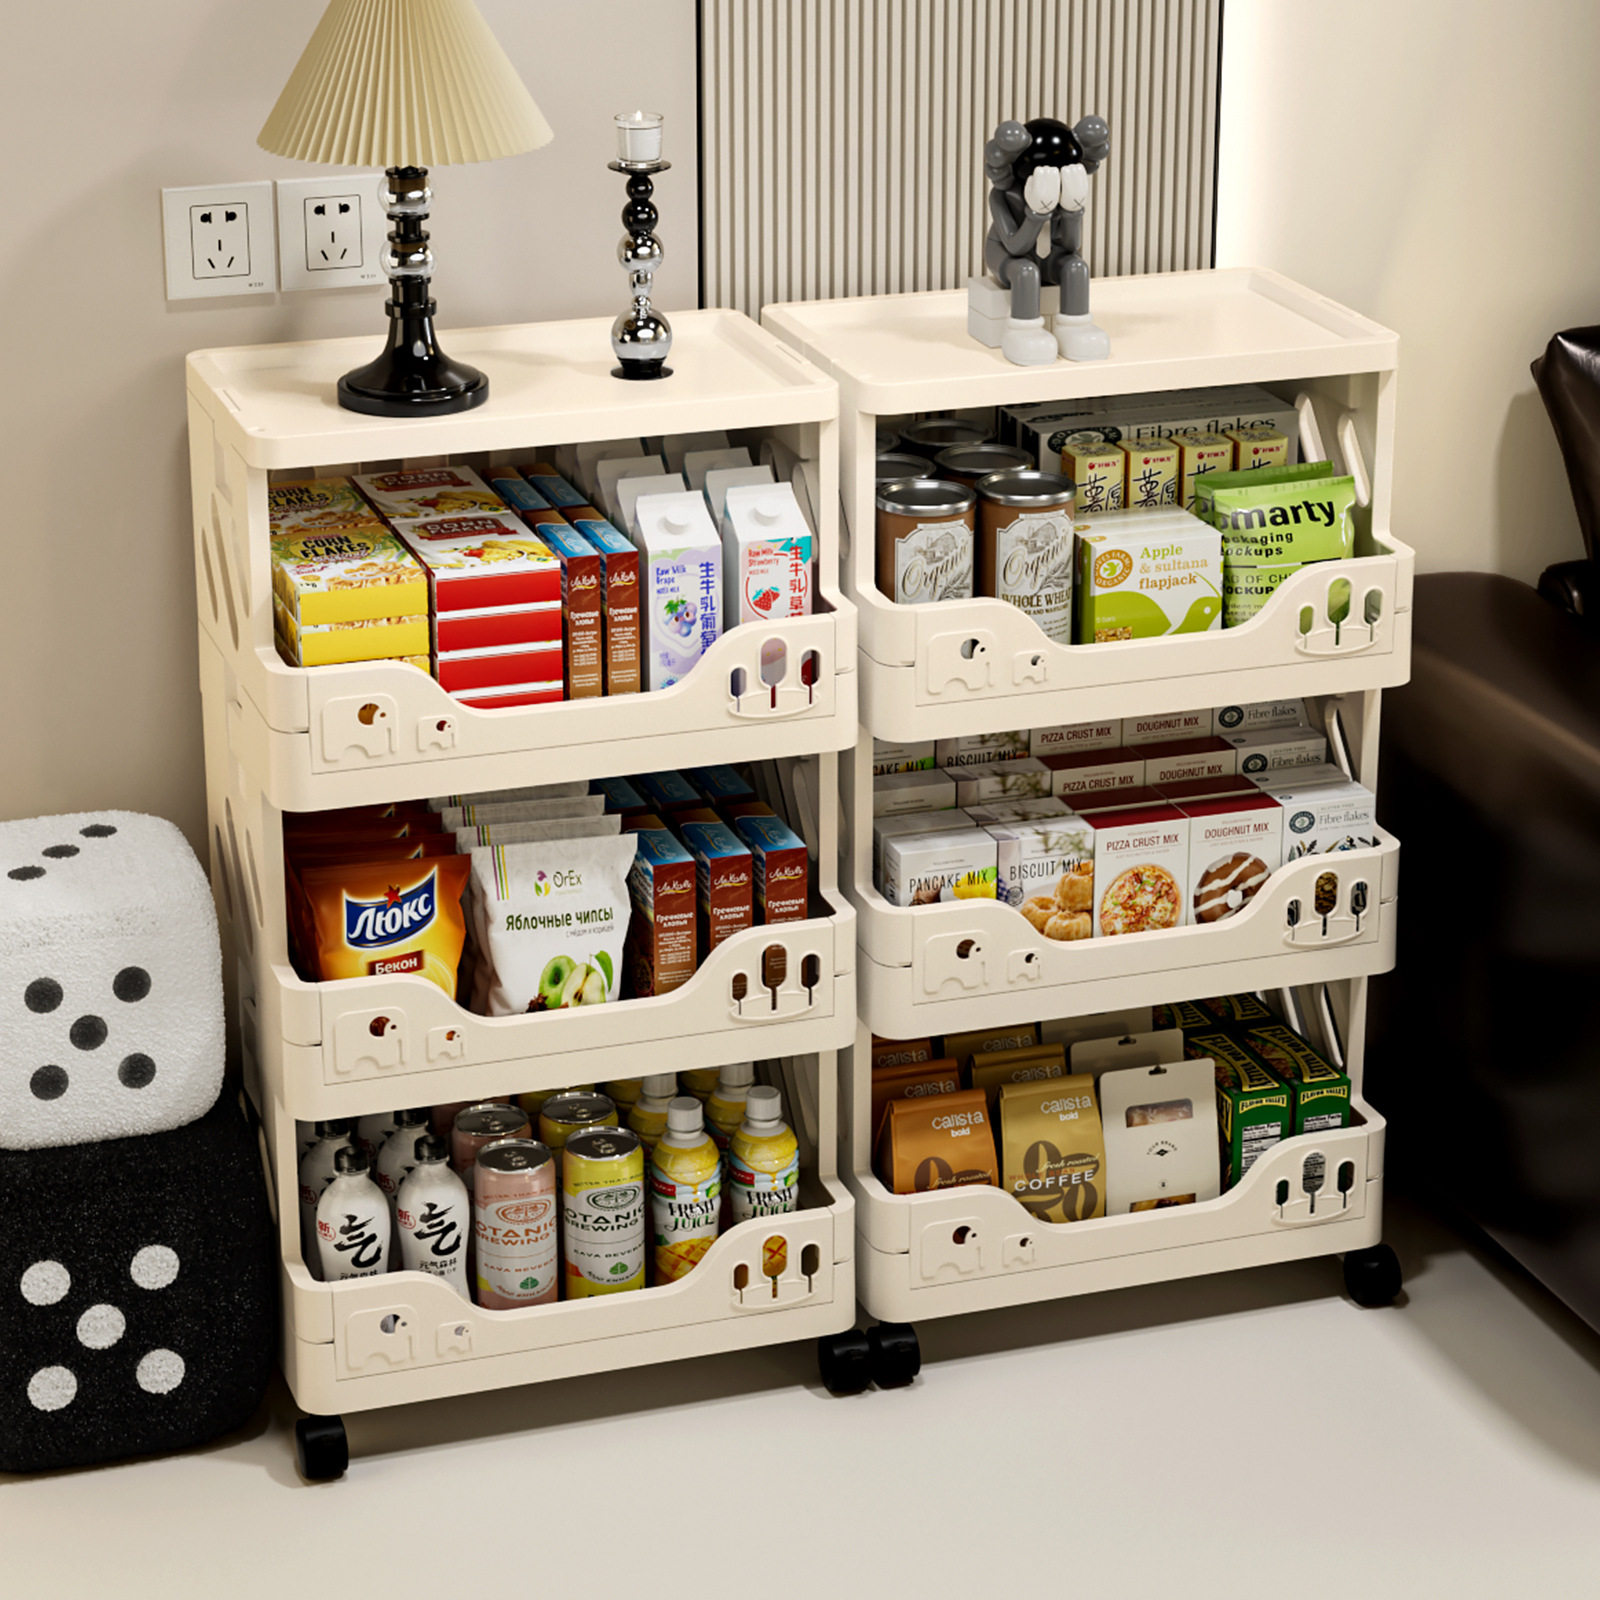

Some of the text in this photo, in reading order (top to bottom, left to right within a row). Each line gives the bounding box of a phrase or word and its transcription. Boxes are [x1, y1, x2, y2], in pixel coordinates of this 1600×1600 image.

[1136, 418, 1276, 439] Fibre flakes
[302, 536, 352, 549] CORN
[1222, 532, 1293, 546] ackaging
[300, 542, 371, 558] FLAKES
[1140, 544, 1183, 560] Apple
[1221, 546, 1283, 558] ockups
[1140, 559, 1208, 574] & sultana
[789, 545, 805, 617] 生牛乳草
[1139, 572, 1197, 590] flapjack
[1223, 585, 1274, 595] OCKUP
[1136, 716, 1199, 733] DOUGHNUT MIX
[1041, 726, 1112, 743] PIZZA CRUST MIX
[1160, 765, 1222, 781] DOUGHNUT MIX
[1063, 775, 1134, 792] PIZZA CRUST MIX
[1205, 822, 1269, 839] DOUGHNUT MIX
[1106, 833, 1179, 852] PIZZA CRUST MIX
[1009, 858, 1083, 881] BISCUIT MIX
[553, 870, 582, 888] OrEx
[909, 872, 960, 893] PANCAKE
[967, 869, 988, 886] MIX
[506, 907, 614, 931] Яблочные чипсы
[375, 957, 418, 975] Бекон
[983, 1034, 1033, 1052] calista
[878, 1049, 928, 1067] calista
[1011, 1064, 1062, 1082] calista
[904, 1080, 956, 1098] calista
[1040, 1095, 1092, 1114] calista
[932, 1111, 985, 1130] calista
[1059, 1111, 1079, 1122] bold
[951, 1126, 971, 1138] bold
[1014, 1169, 1094, 1192] COFFEE
[747, 1187, 792, 1208] FRESH
[668, 1199, 714, 1219] FRESH
[664, 1215, 714, 1232] JUICE
